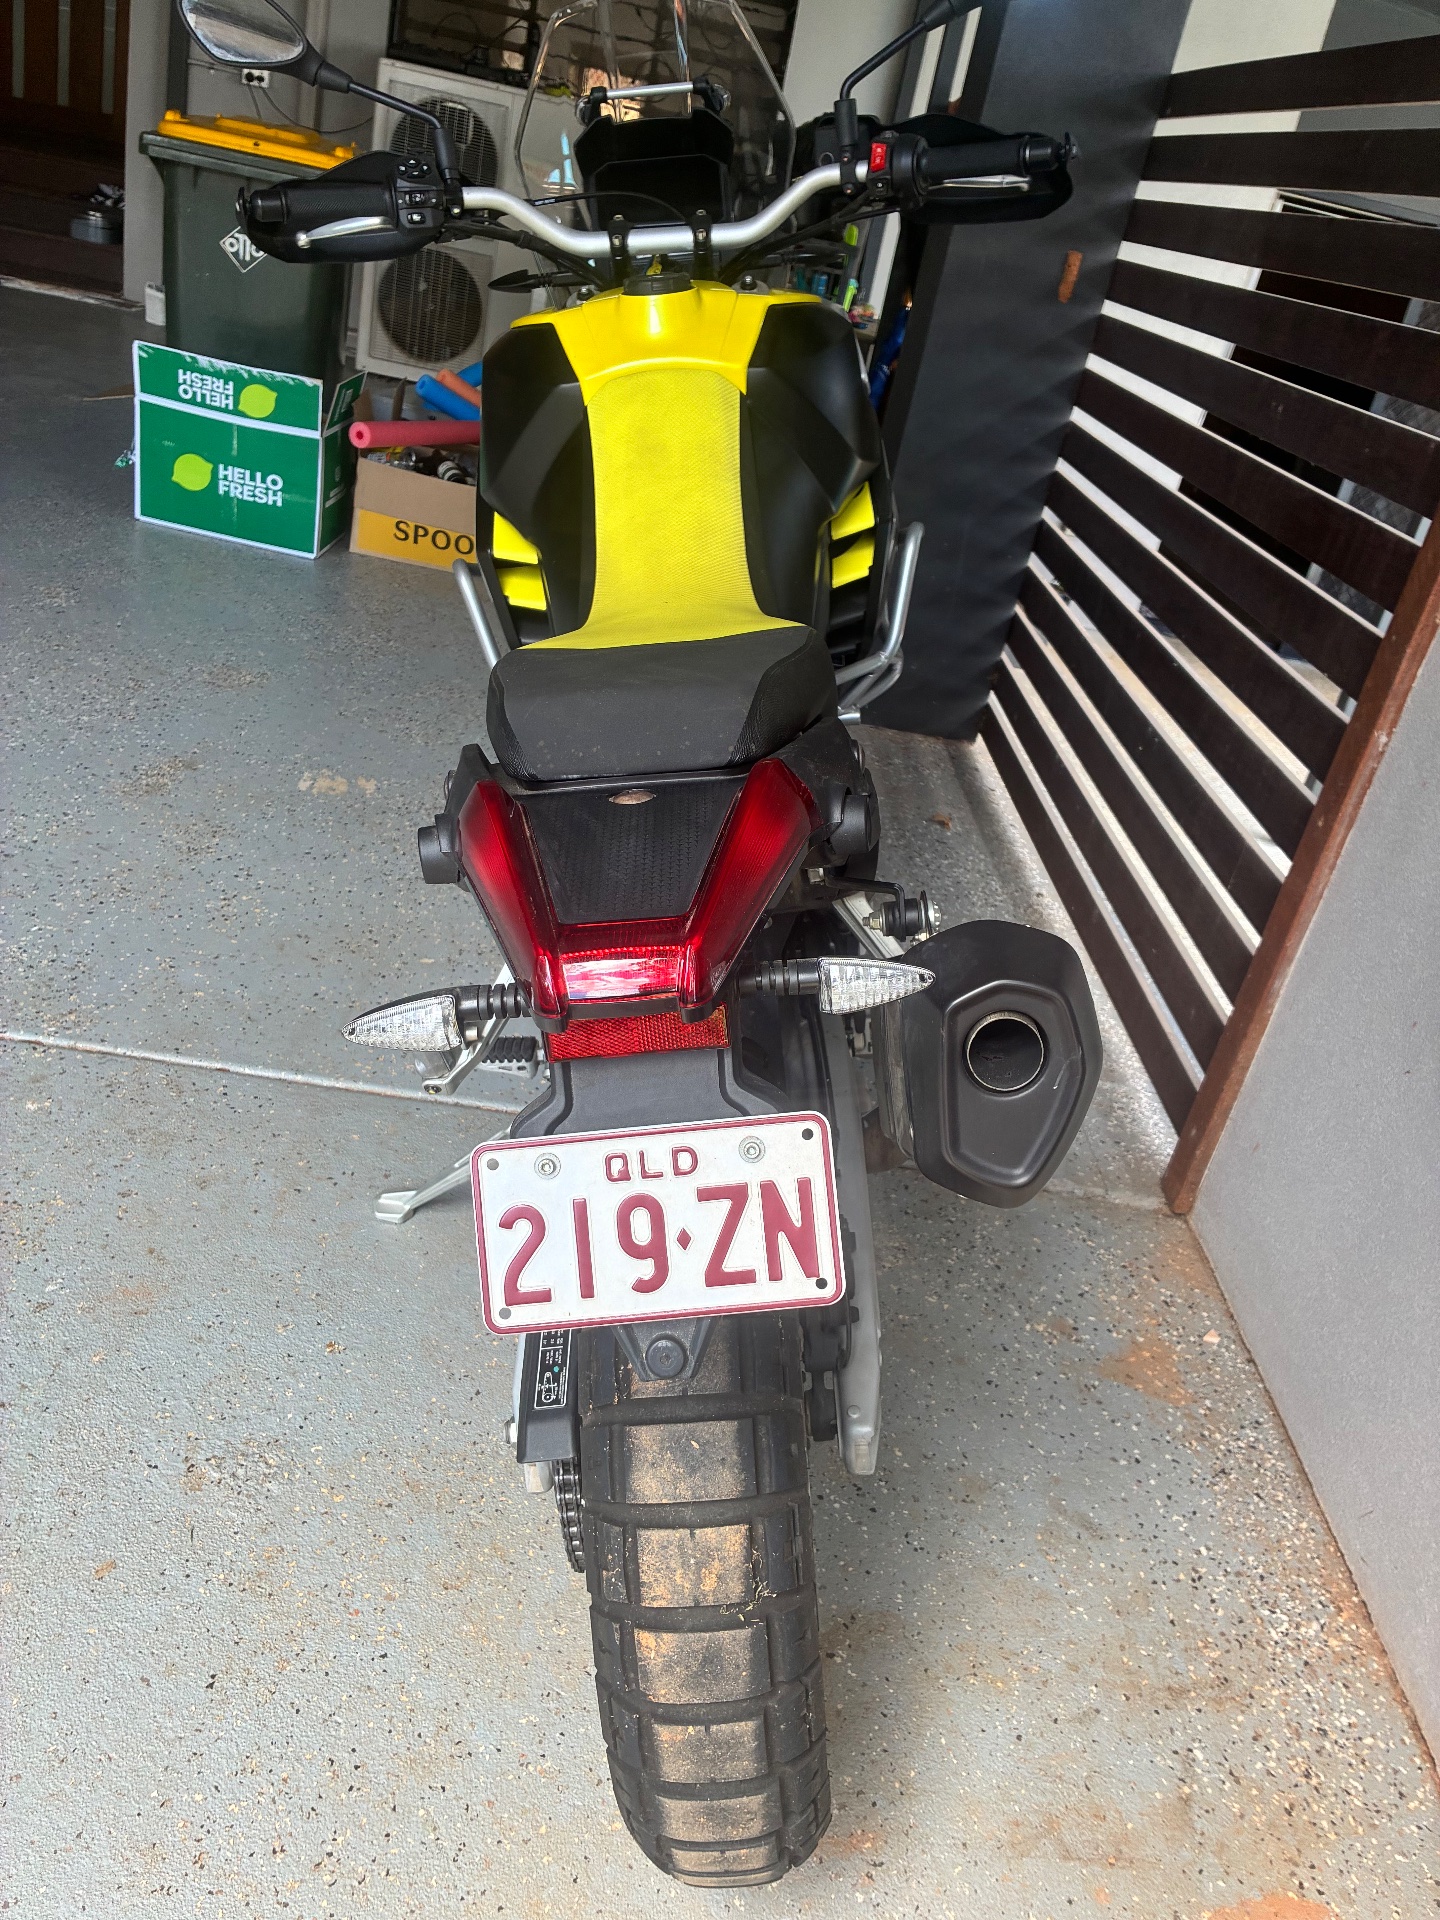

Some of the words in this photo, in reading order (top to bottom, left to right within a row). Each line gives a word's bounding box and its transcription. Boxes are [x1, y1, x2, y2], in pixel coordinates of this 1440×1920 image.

[178, 368, 234, 395] FRESH
[178, 385, 234, 410] HELLO
[218, 463, 284, 491] HELLO
[218, 479, 283, 507] FRESH
[393, 519, 475, 555] SPOO
[604, 1146, 699, 1182] QLD
